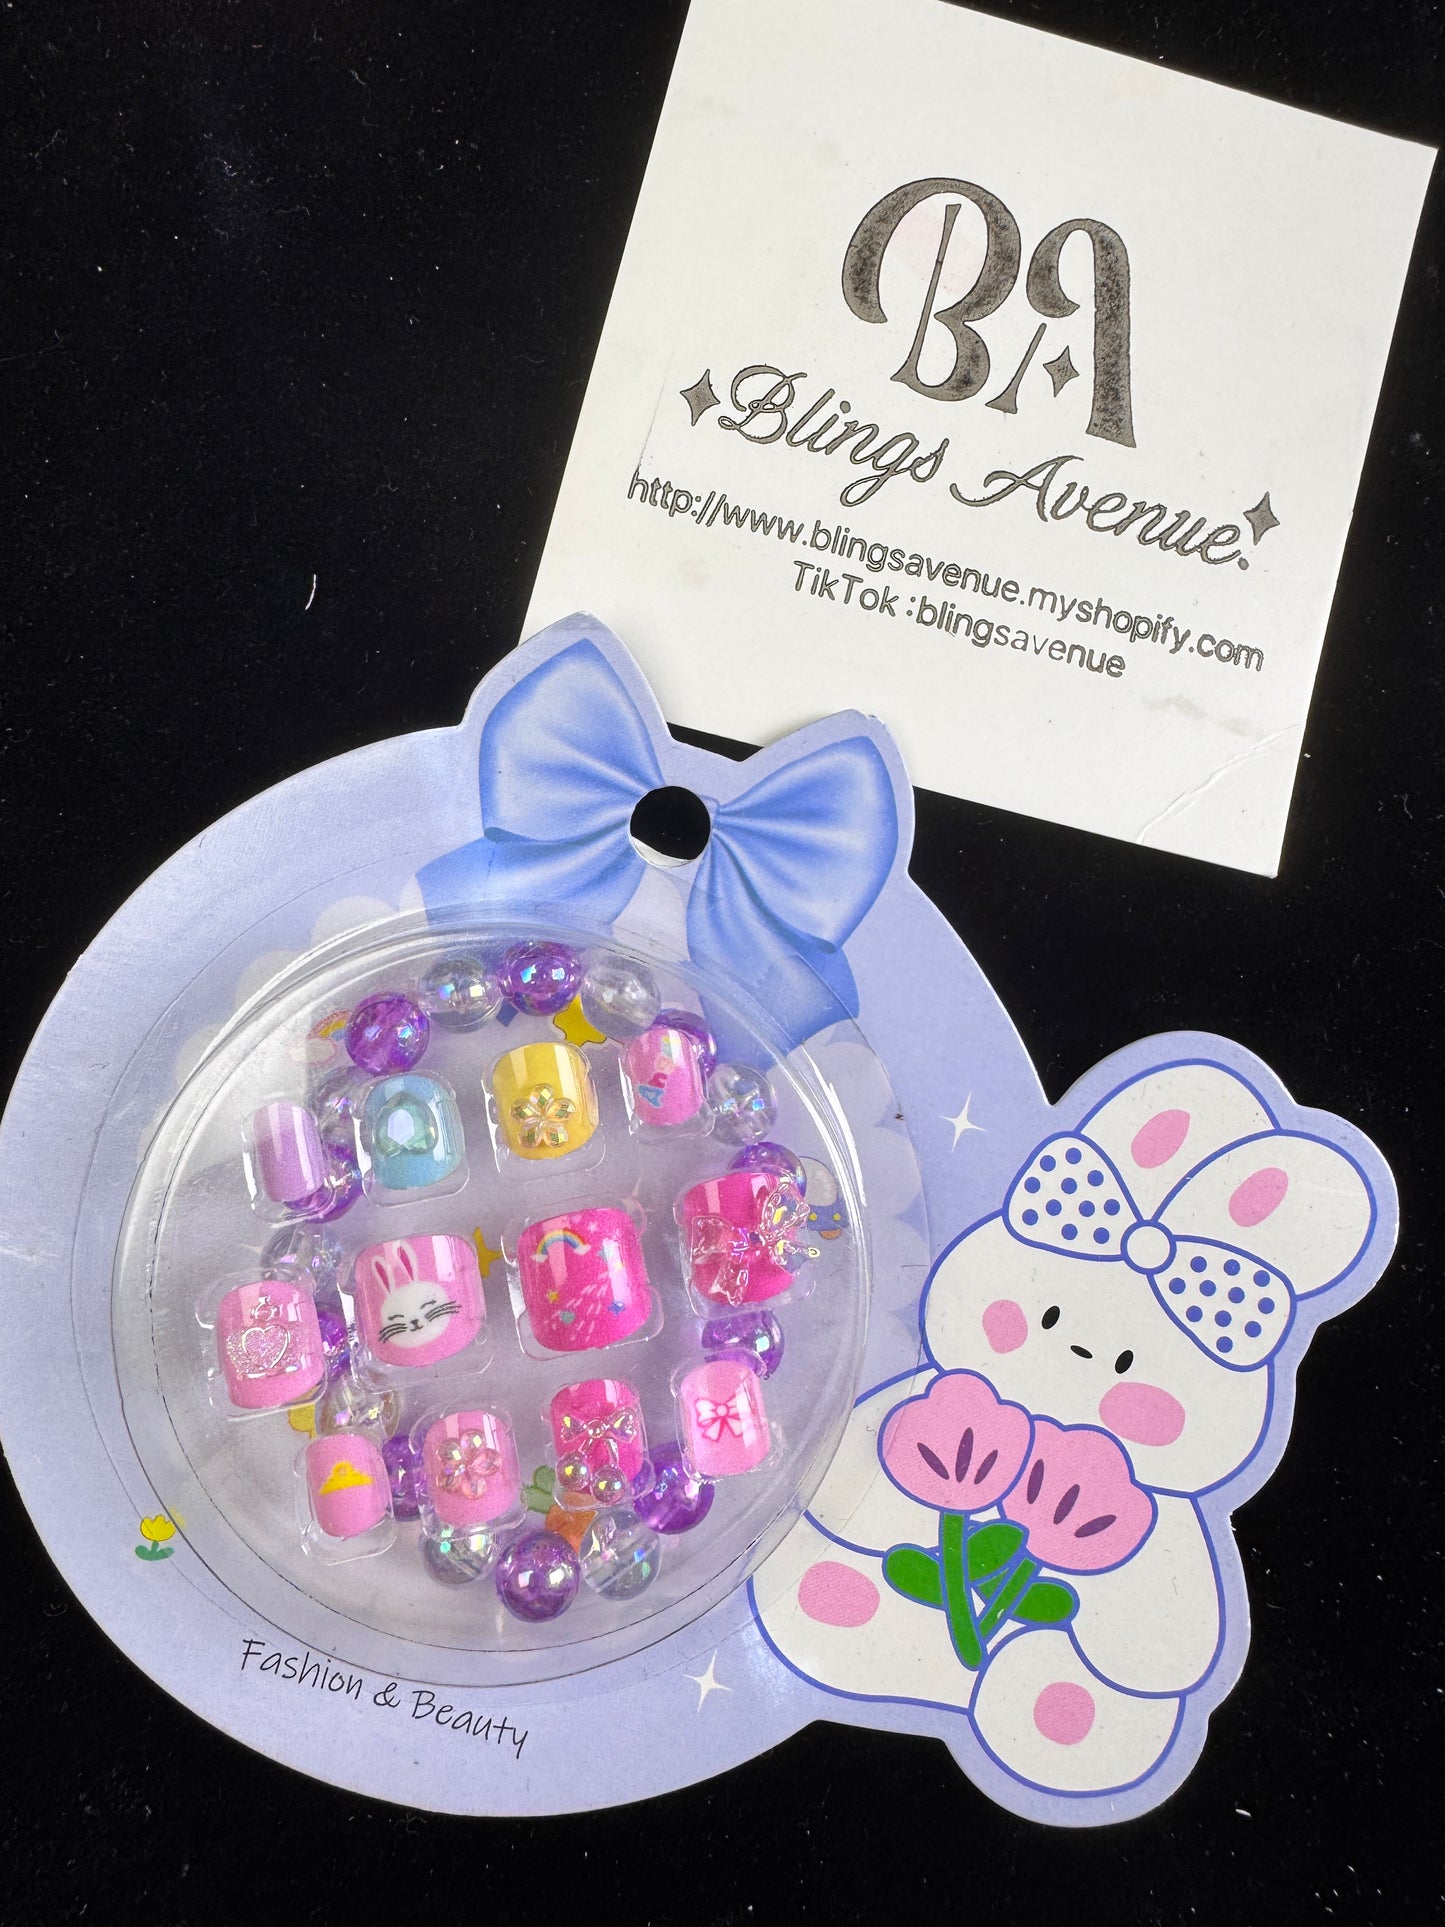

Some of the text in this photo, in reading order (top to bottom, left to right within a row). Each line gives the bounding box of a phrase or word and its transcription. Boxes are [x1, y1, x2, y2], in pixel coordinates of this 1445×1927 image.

[718, 363, 950, 508] Blings
[627, 464, 1265, 672] http://www.blingsavenue.myshopify.com
[793, 560, 900, 618] TikTok
[241, 1638, 529, 1760] Fashion & Beauty
